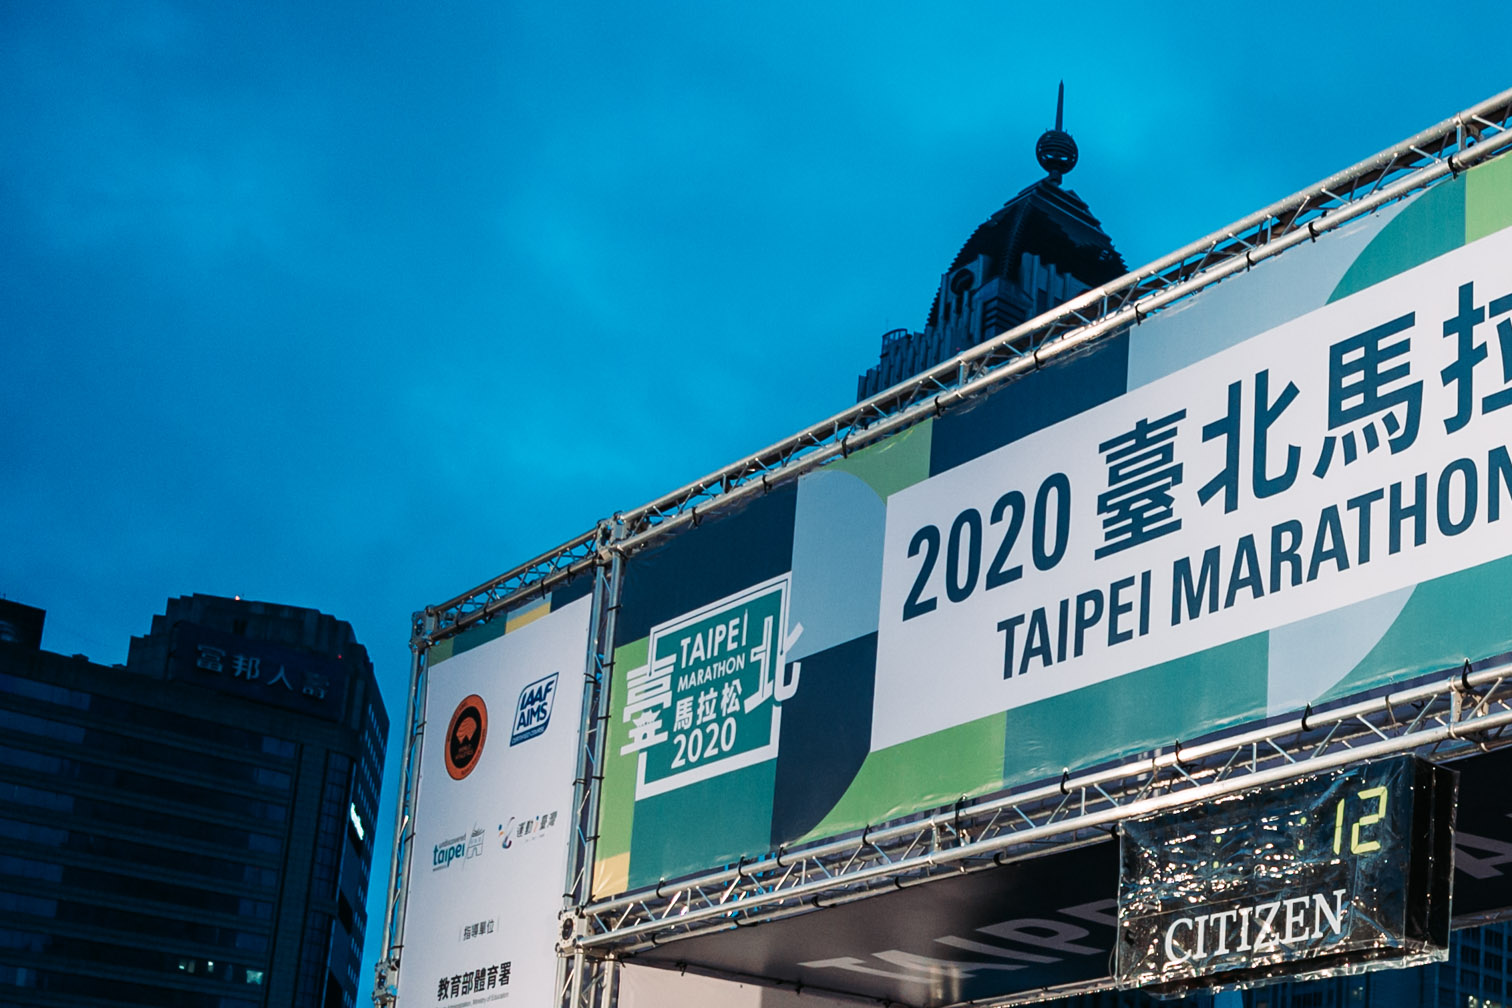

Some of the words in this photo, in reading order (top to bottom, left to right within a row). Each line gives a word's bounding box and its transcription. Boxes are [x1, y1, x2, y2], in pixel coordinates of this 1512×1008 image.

[902, 471, 1072, 622] 2020
[679, 608, 749, 669] TAIPEI
[997, 569, 1152, 679] TAIPEI
[197, 644, 330, 701] 富邦人壽
[520, 680, 554, 710] IAAF
[677, 653, 745, 692] MARATHON
[517, 702, 548, 731] AIMS
[673, 678, 742, 732] 馬拉松
[671, 717, 737, 769] 2020
[1333, 786, 1387, 855] 12
[433, 842, 465, 867] taipei
[463, 919, 495, 941] 指導單位
[797, 899, 1118, 984] TAIP
[1164, 888, 1346, 965] CITIZEN
[437, 961, 512, 1001] 教育部體育署
